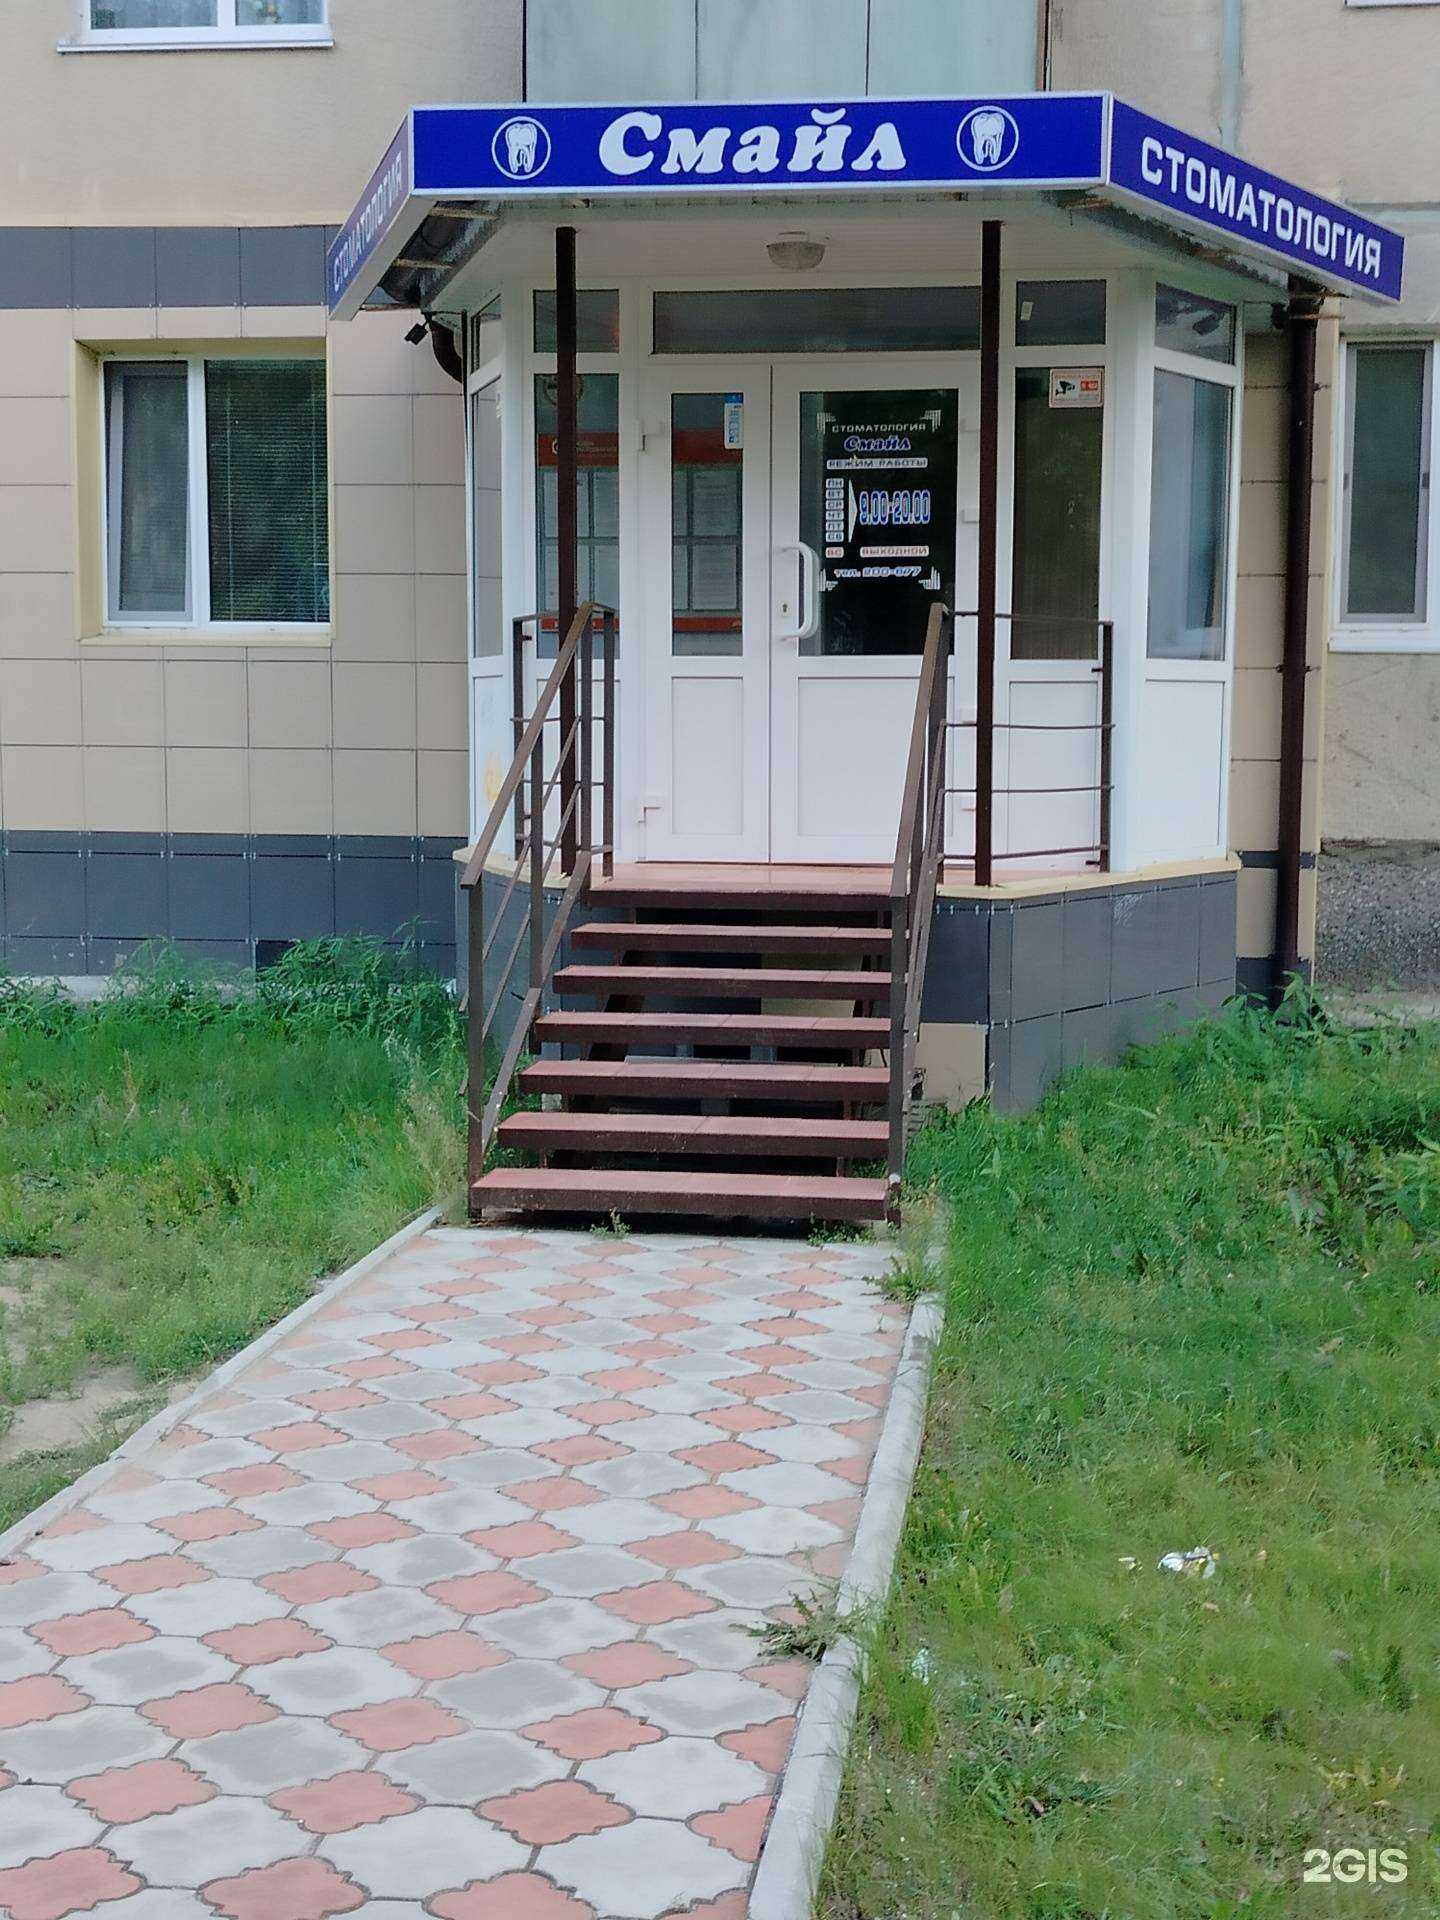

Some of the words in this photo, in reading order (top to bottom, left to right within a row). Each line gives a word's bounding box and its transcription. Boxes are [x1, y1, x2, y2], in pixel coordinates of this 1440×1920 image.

[598, 108, 907, 176] Смайл
[333, 151, 402, 283] СТОМАТОЛОГИЯ
[1141, 136, 1382, 279] СТОМАТОЛОГИЯ
[832, 423, 927, 433] СТОМАТОЛОГИЯ
[843, 435, 912, 452] Смайл
